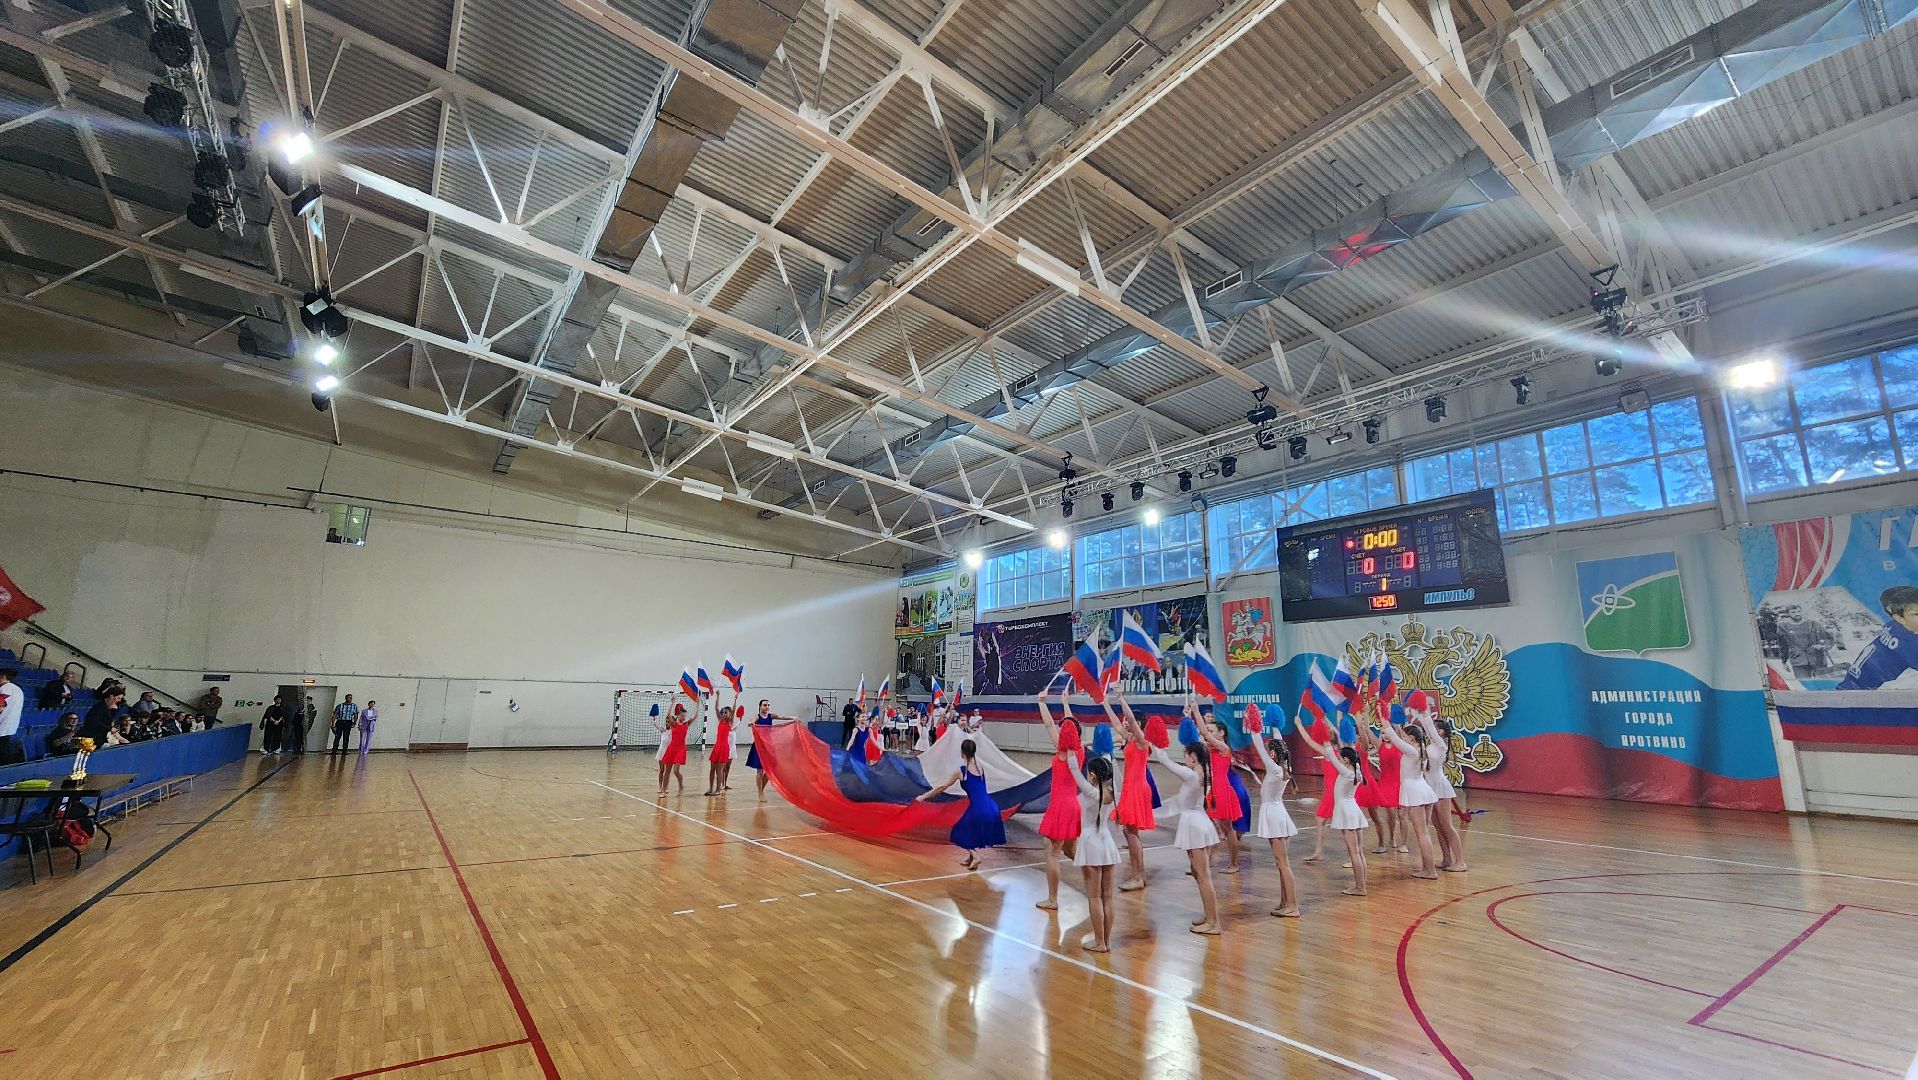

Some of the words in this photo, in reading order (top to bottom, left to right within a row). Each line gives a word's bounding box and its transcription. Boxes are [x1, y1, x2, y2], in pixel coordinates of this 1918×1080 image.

[1363, 529, 1398, 550] 0:00
[1424, 587, 1475, 605] ИМПУЛЬС
[1015, 641, 1066, 659] ЭНЕРГИЯ
[1012, 656, 1065, 673] СПОРТА
[1591, 690, 1702, 704] АДМИНИСТРАЦИЯ
[1624, 712, 1673, 726] ГОРОДА
[1621, 735, 1686, 748] ПРОТВИНО
